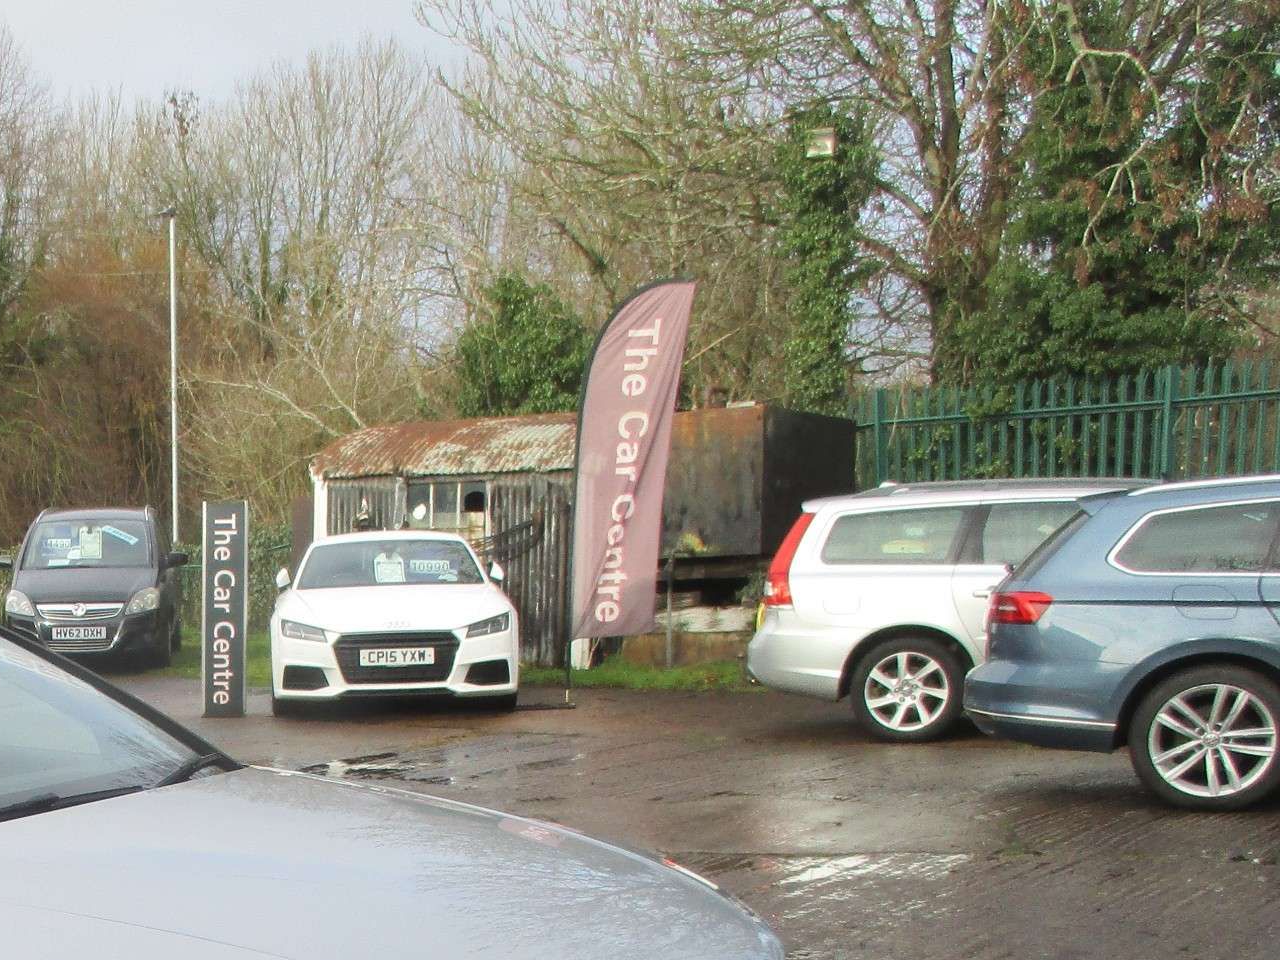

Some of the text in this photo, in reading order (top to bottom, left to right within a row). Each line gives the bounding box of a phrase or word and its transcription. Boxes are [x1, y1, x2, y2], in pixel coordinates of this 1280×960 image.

[594, 318, 662, 623] The Car Centre
[56, 628, 102, 638] HV62 DXH
[212, 513, 238, 705] The Car Centre
[368, 649, 426, 663] CP15 YXW
